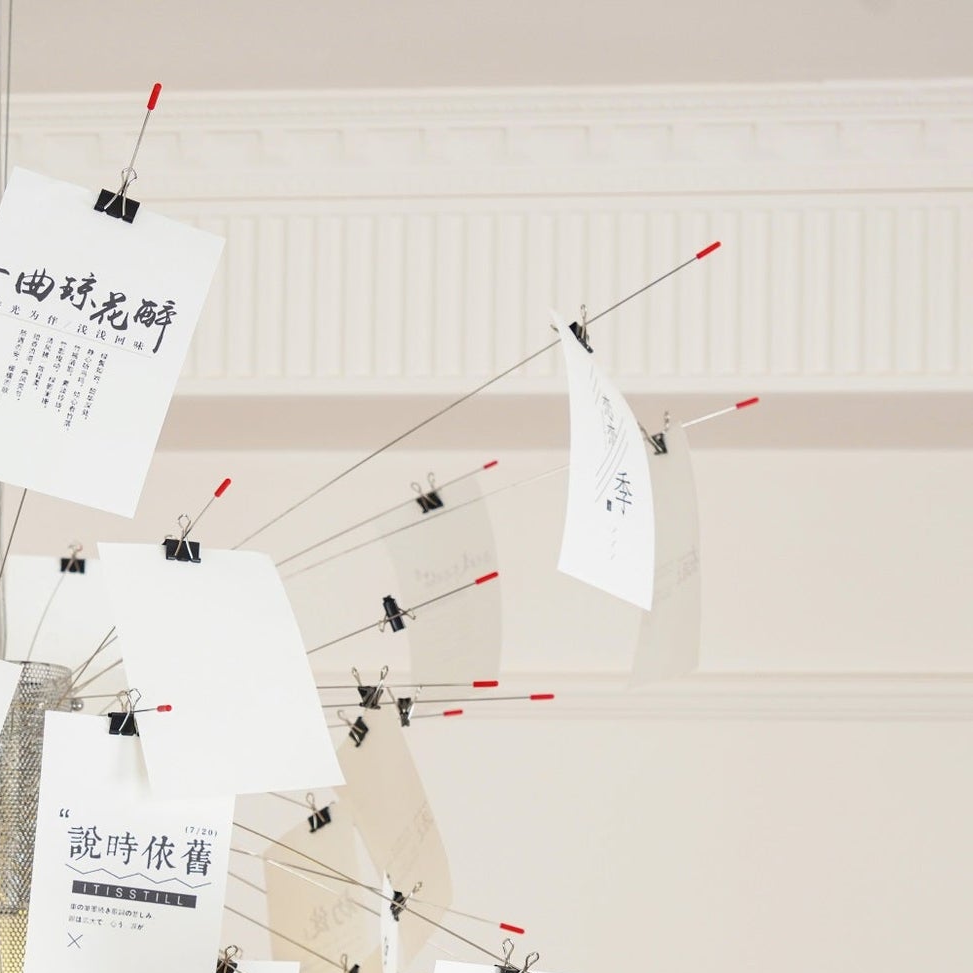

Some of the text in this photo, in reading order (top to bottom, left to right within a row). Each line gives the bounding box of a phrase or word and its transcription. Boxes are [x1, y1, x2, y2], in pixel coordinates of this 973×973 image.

[184, 826, 218, 838] (7/20)
[67, 825, 213, 877] 說時依舊
